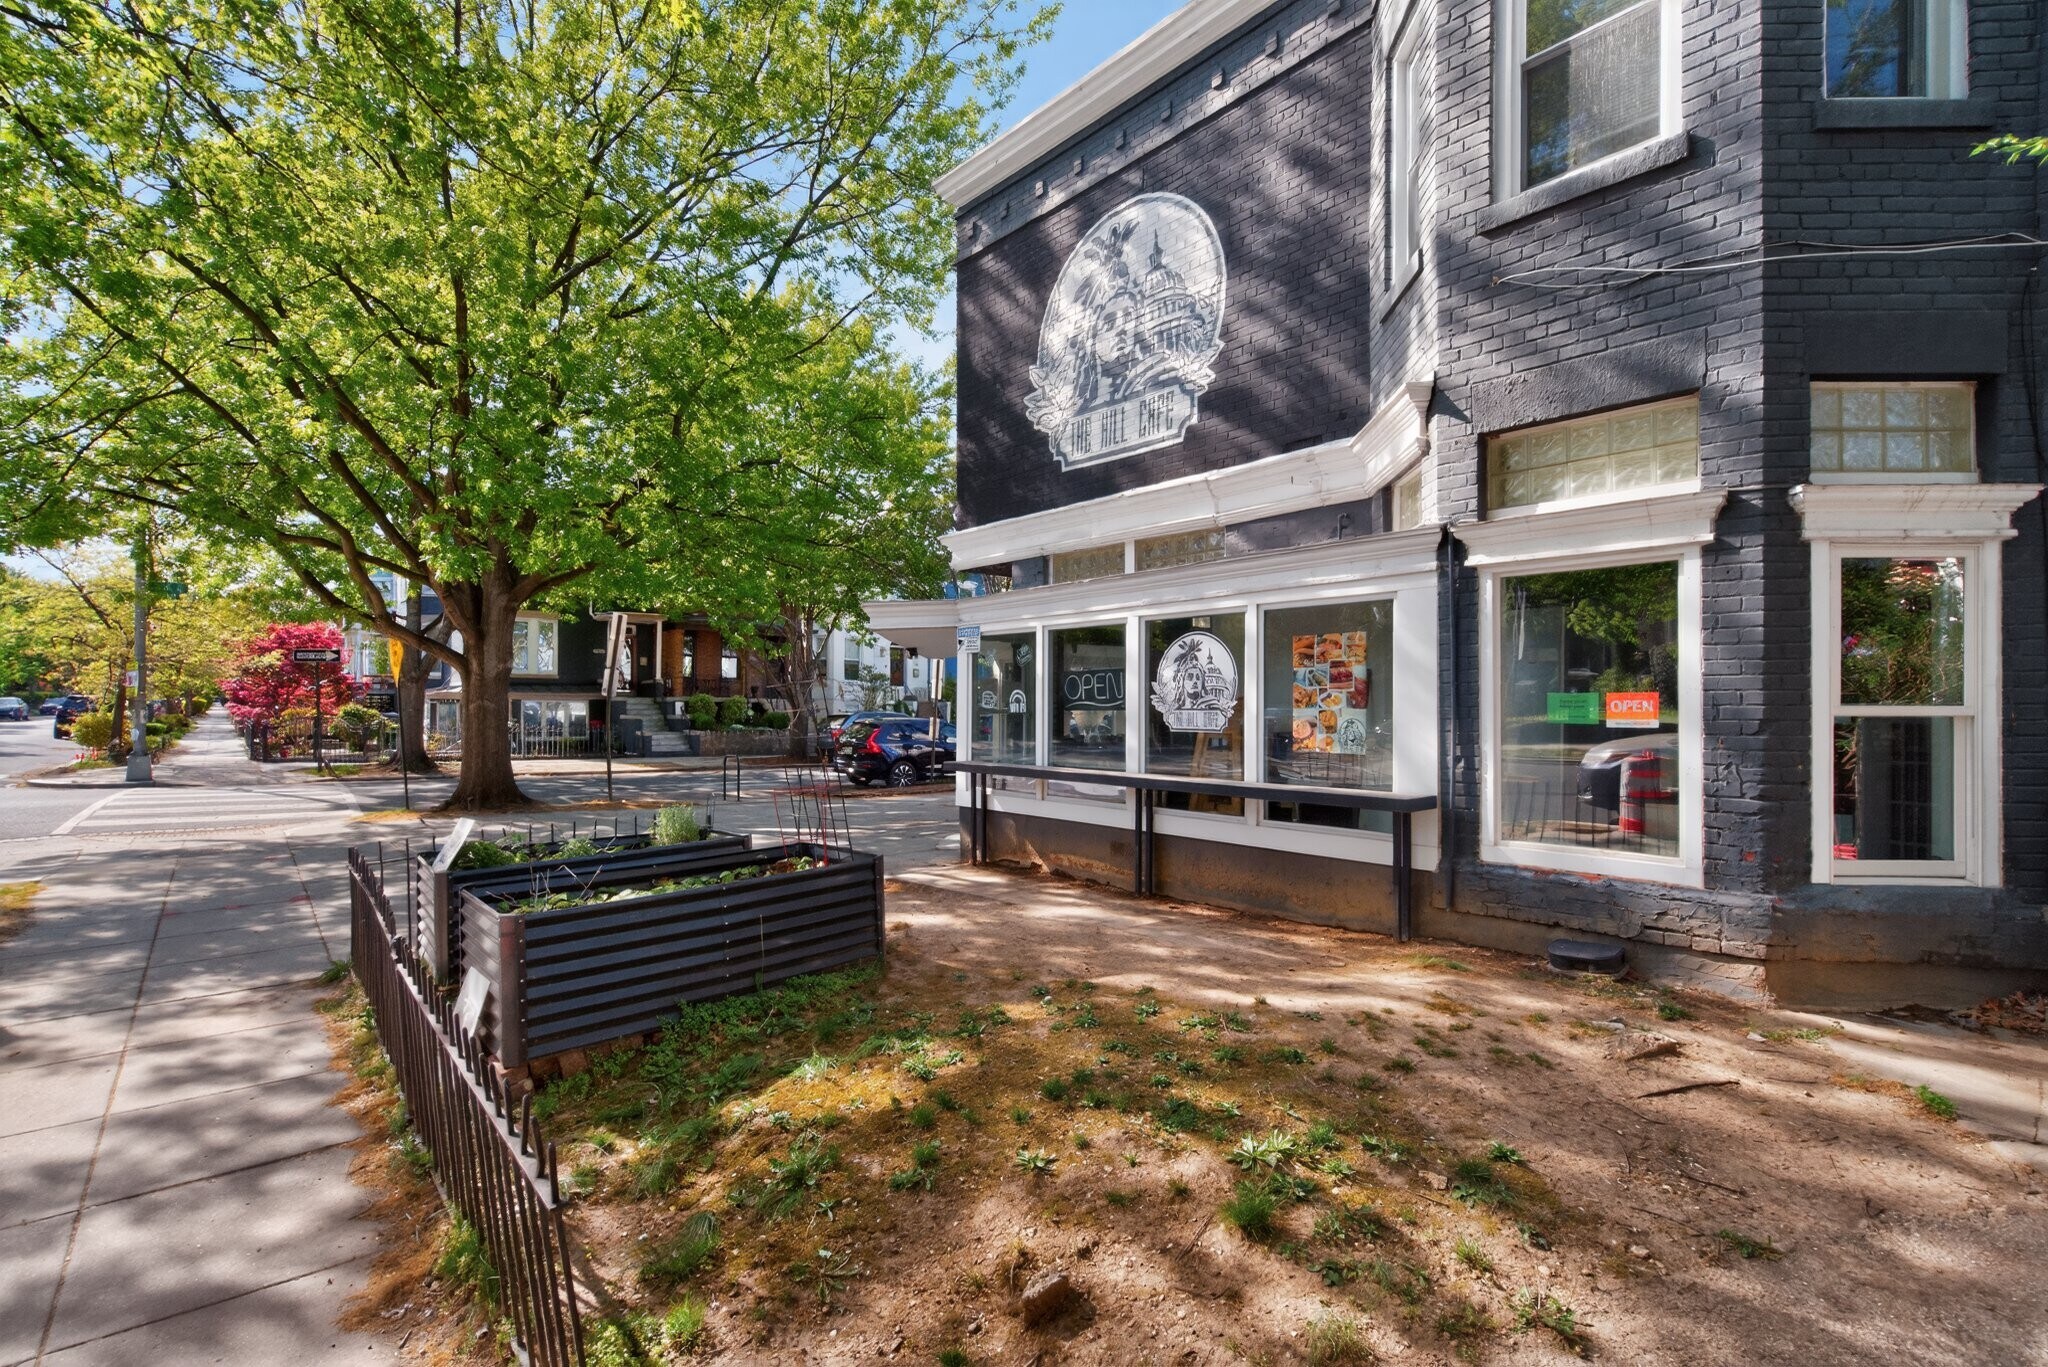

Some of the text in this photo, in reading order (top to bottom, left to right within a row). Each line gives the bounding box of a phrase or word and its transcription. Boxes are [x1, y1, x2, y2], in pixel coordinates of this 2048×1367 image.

[1101, 406, 1128, 449] HILL
[1065, 672, 1124, 700] OPEN
[1610, 700, 1654, 713] OPEN
